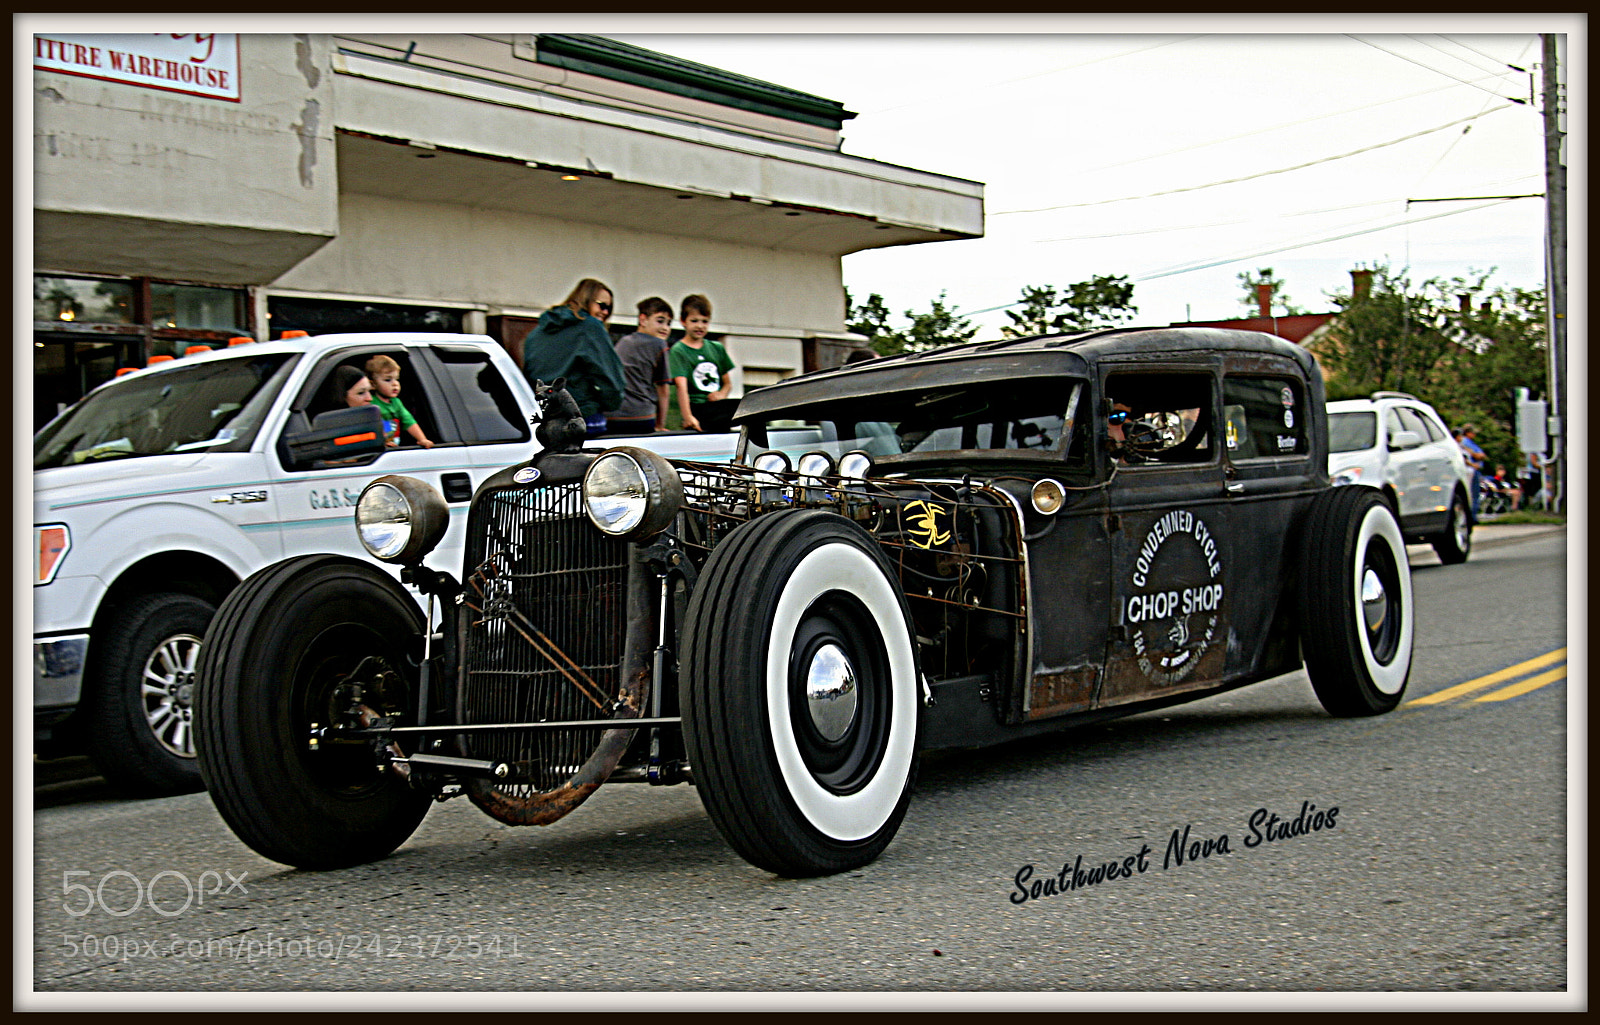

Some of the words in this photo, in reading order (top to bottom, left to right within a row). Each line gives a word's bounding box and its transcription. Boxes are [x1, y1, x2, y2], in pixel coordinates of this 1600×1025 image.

[35, 37, 102, 68] ITURE
[108, 50, 230, 90] WAREHOUSE
[1133, 510, 1193, 587] CONDEMNED
[1195, 520, 1221, 578] CYCLE
[1127, 591, 1179, 623] CHOP
[1182, 584, 1223, 614] SHOP
